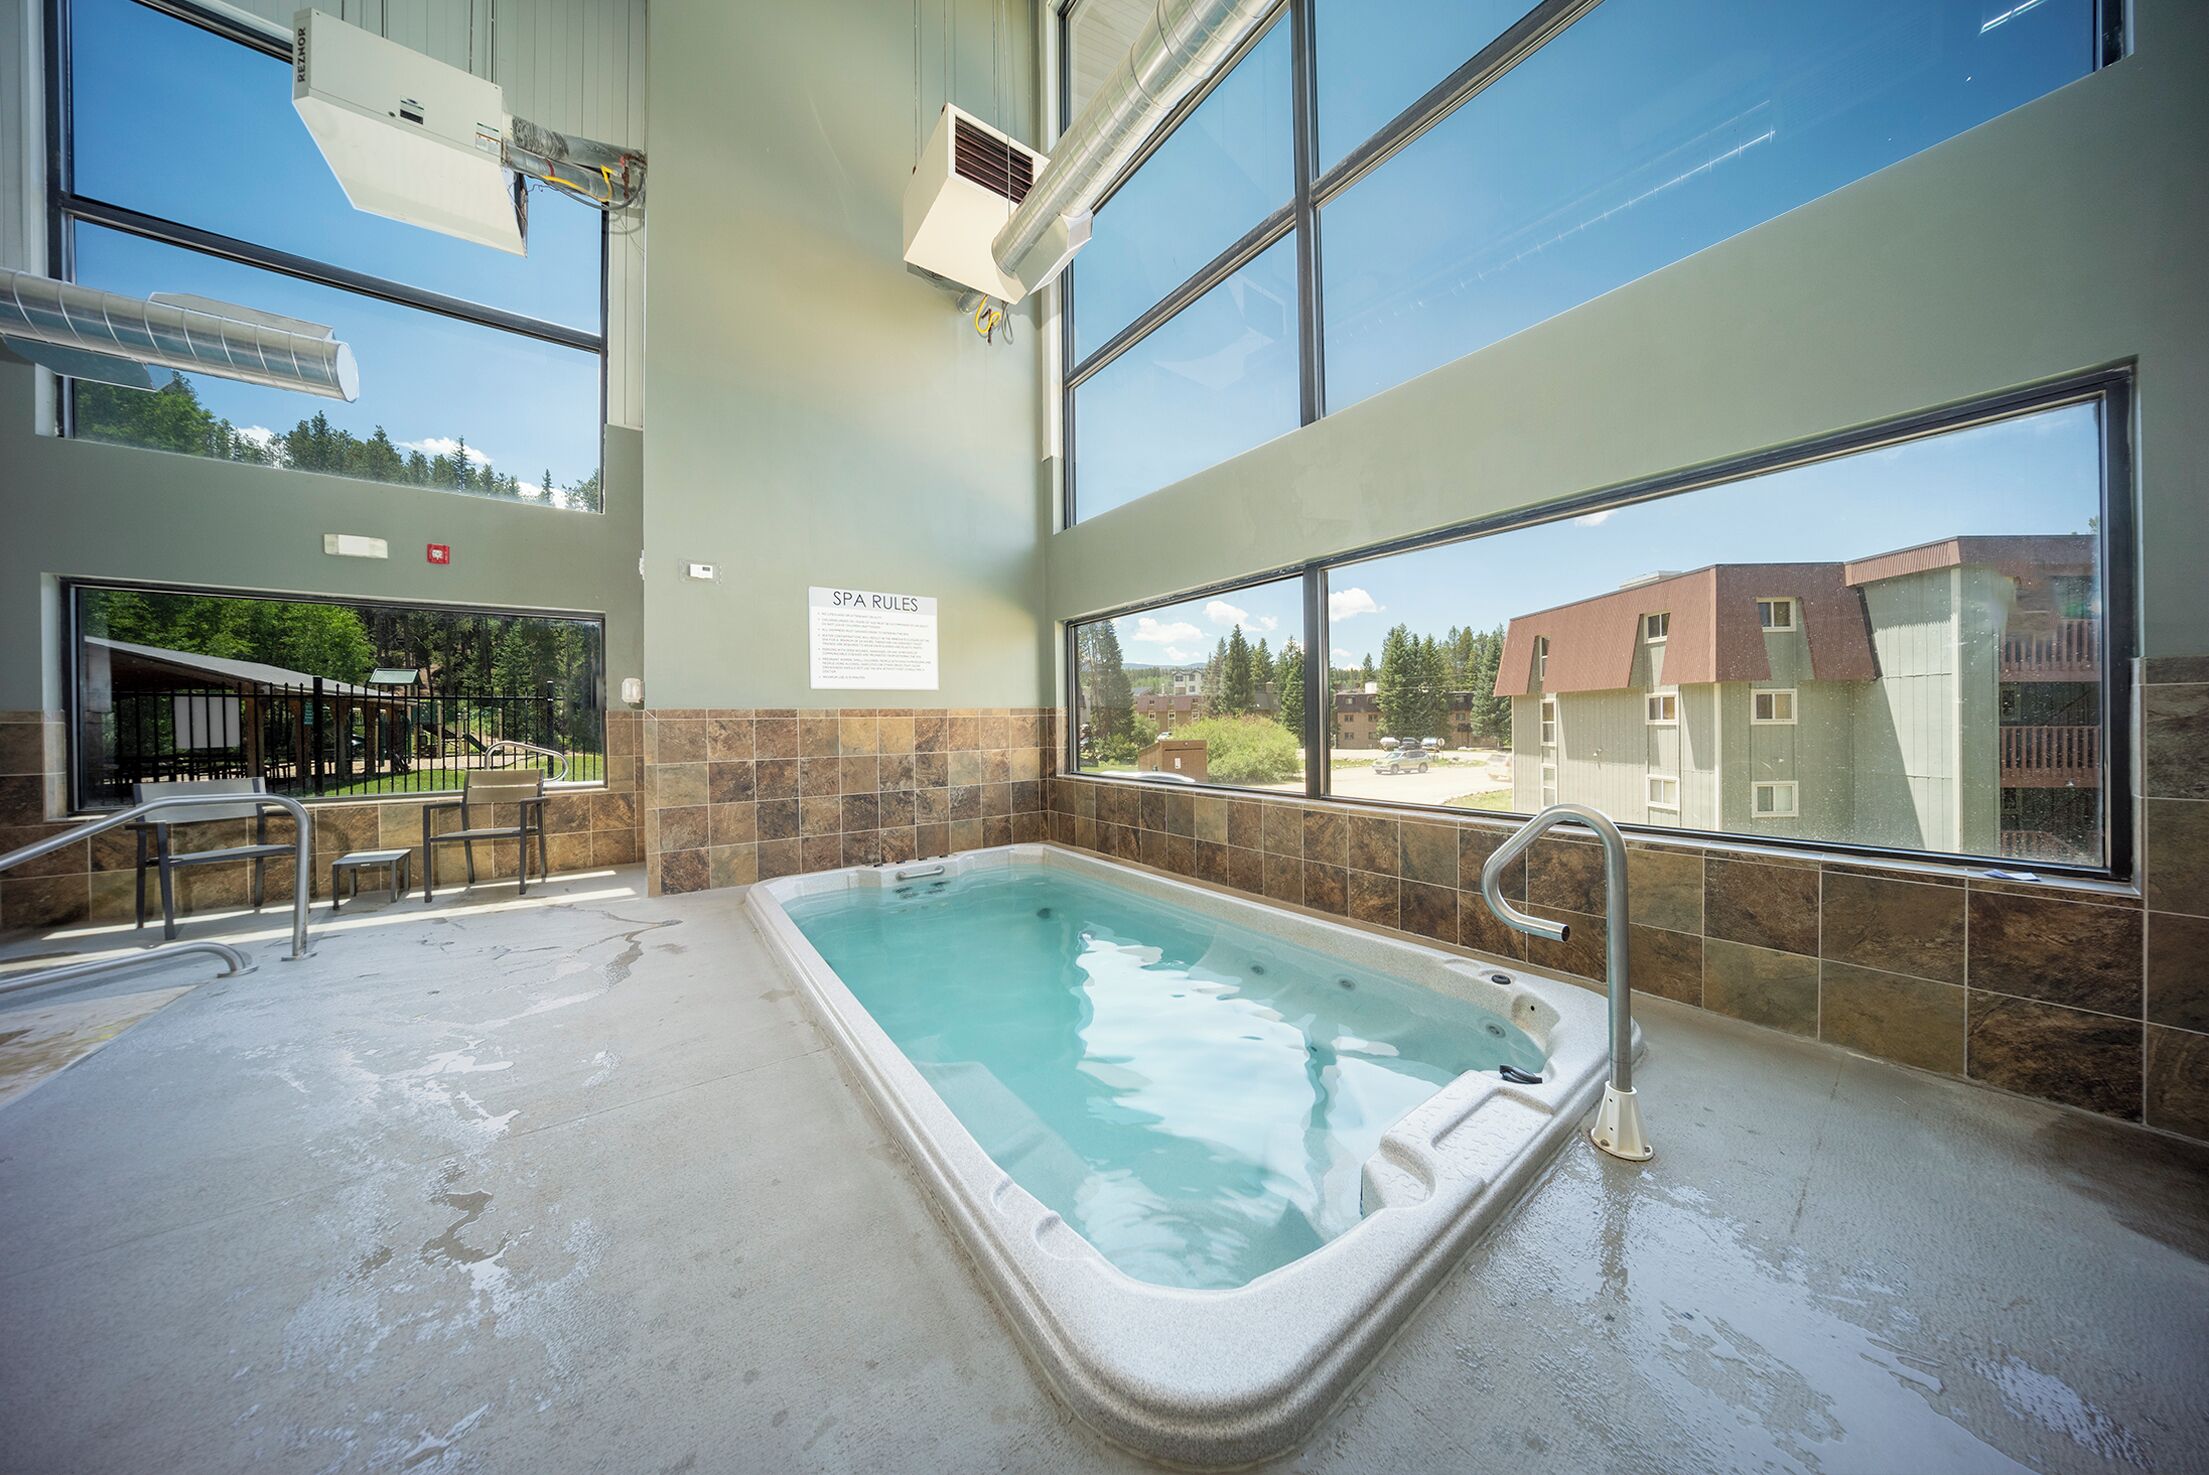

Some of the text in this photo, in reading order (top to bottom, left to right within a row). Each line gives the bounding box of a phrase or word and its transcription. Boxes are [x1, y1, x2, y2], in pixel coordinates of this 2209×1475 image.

[297, 27, 306, 83] REZNOR
[833, 590, 919, 612] SPA RULES
